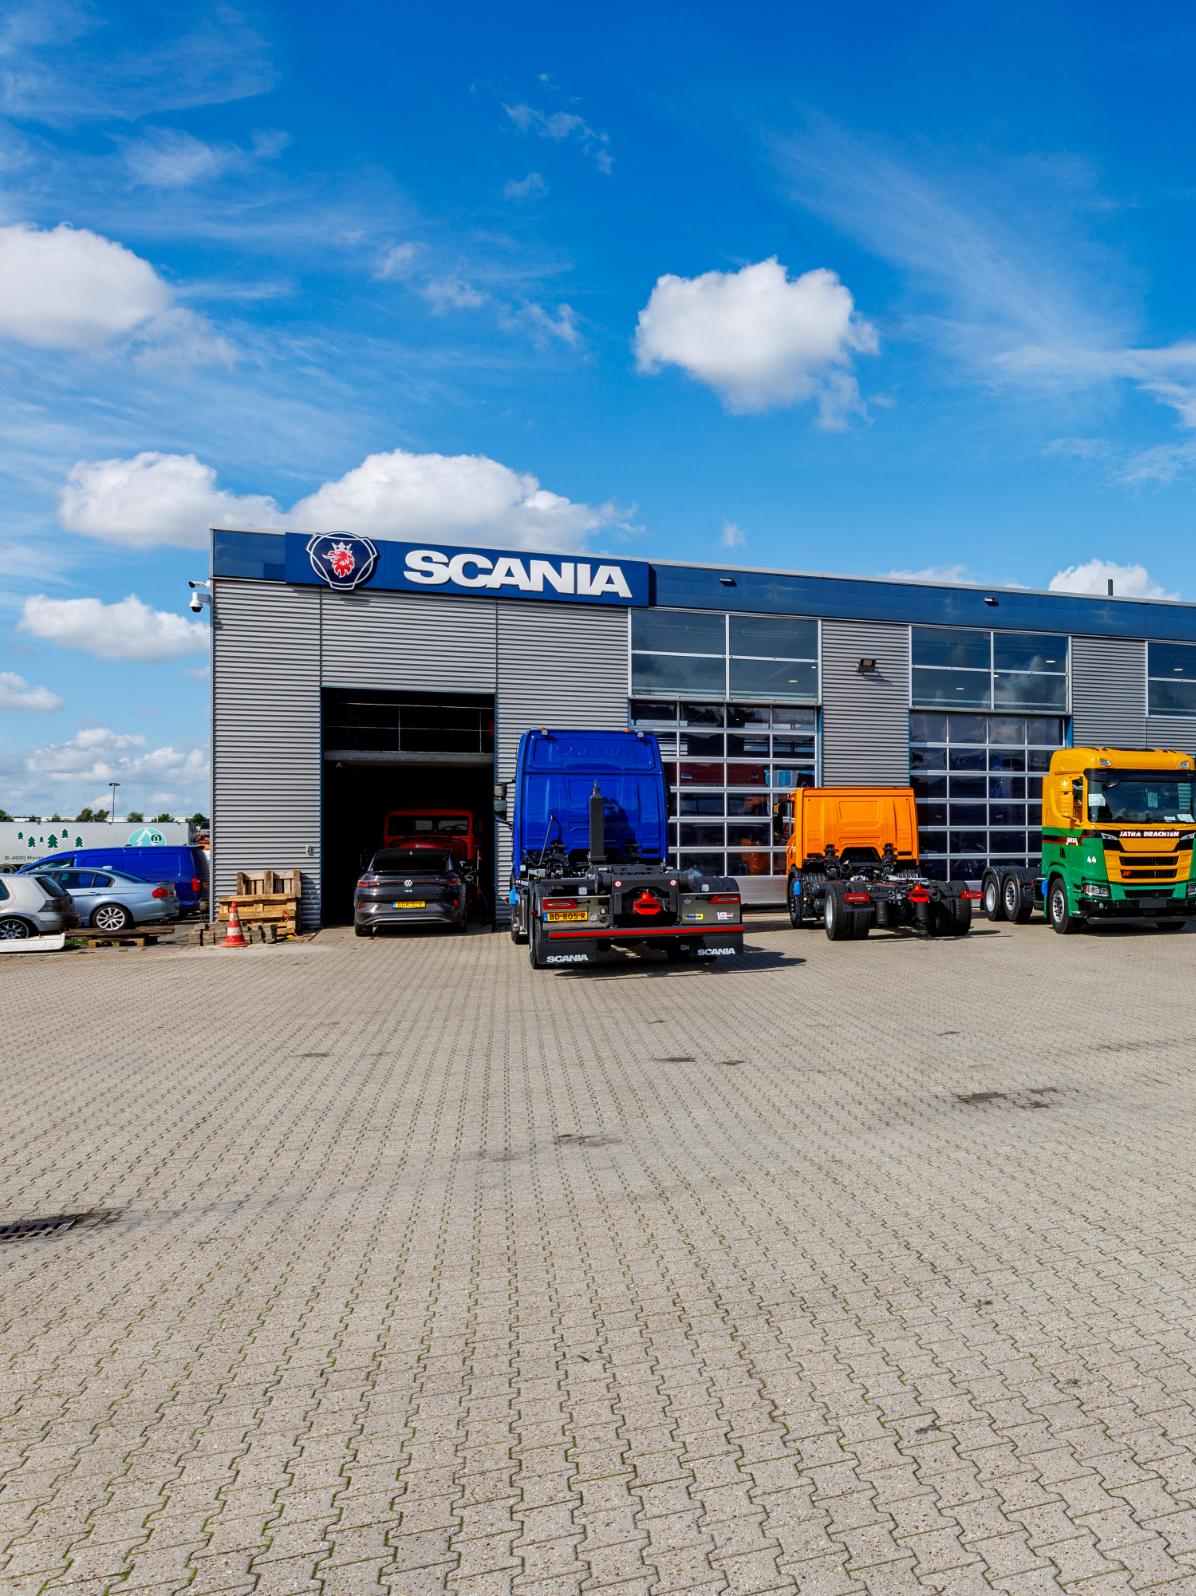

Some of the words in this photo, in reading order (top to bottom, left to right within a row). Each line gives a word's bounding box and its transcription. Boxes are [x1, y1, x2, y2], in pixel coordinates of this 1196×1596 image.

[403, 549, 633, 599] SCANIA
[697, 947, 736, 956] SCANIA
[546, 953, 589, 963] SCANIA
